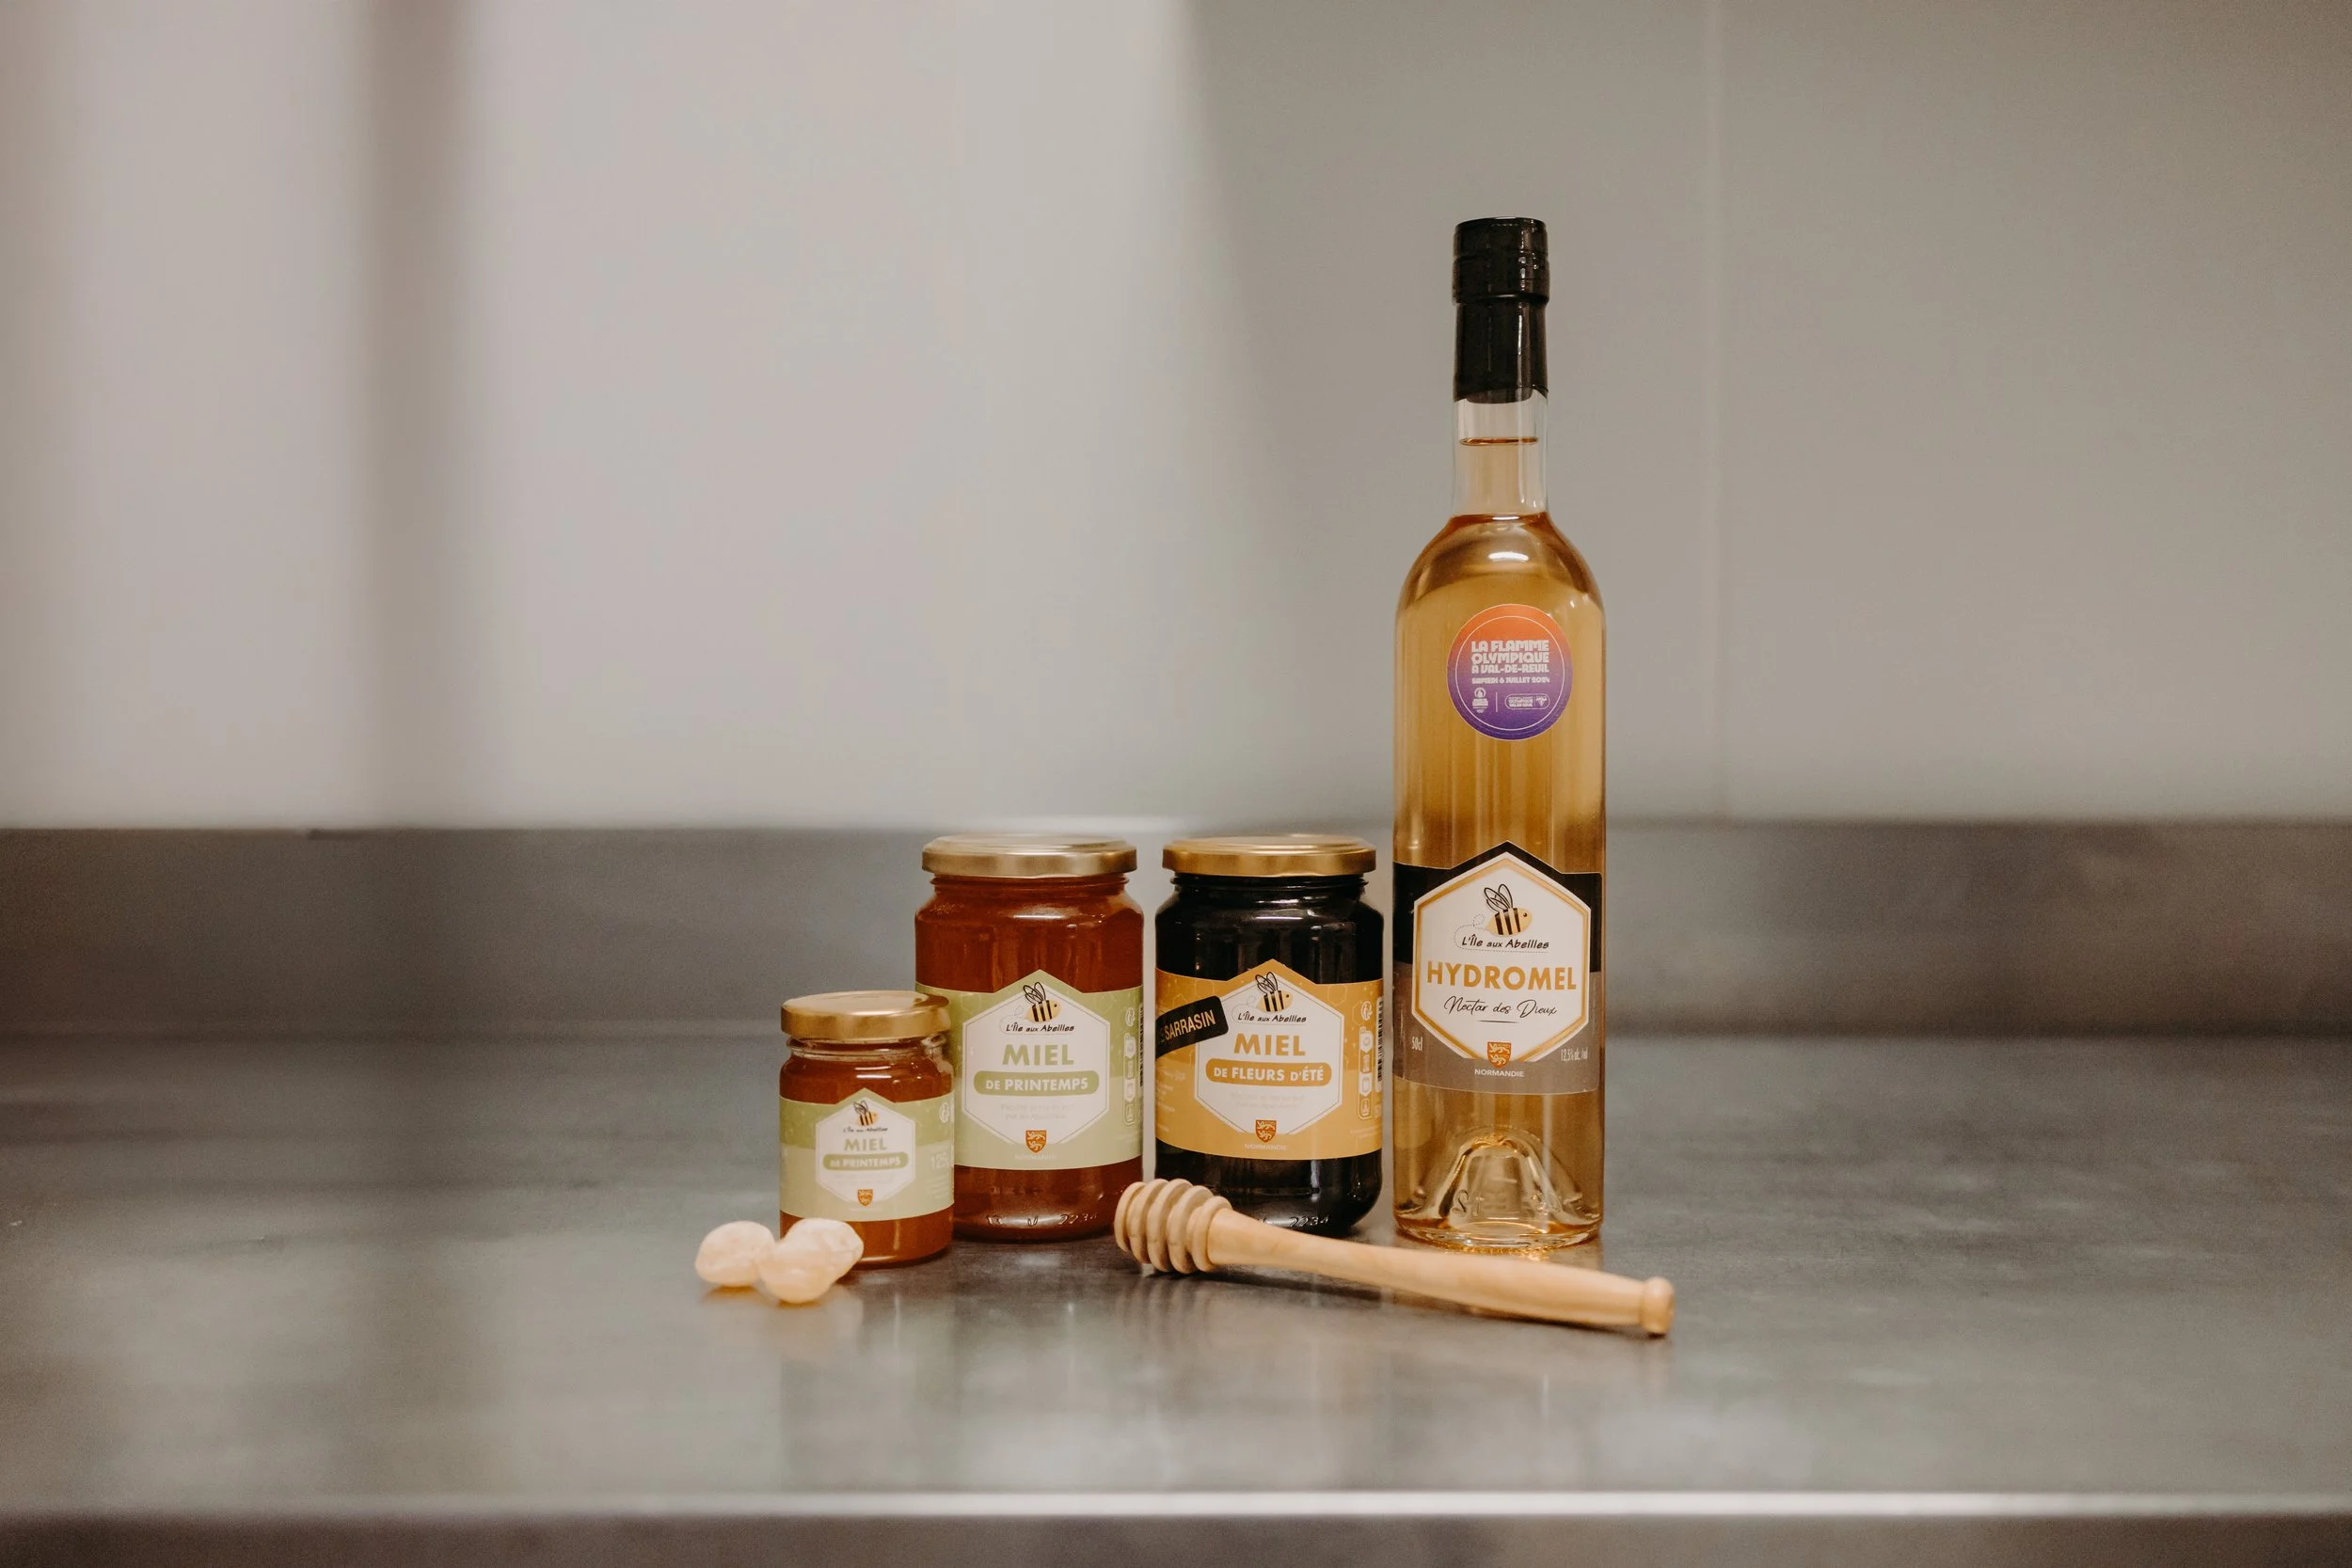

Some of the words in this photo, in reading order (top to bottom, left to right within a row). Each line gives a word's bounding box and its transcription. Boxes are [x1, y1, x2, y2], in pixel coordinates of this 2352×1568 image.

[1471, 641, 1488, 652] LA
[1491, 640, 1549, 652] FLAMME
[1471, 652, 1549, 665] OLYMPIQUE
[1481, 663, 1549, 673] VAL-DE-REUIL
[1461, 934, 1483, 947] L'Île
[1505, 939, 1549, 949] Abeilles
[1427, 961, 1577, 990] HYDROMEL
[1444, 996, 1488, 1016] Nectar
[1492, 1002, 1511, 1014] des
[1517, 1000, 1557, 1019] Dieux
[1164, 1009, 1216, 1041] SARRASIN
[1272, 1014, 1307, 1023] Abeilles
[1041, 1023, 1074, 1033] Abeilles
[1233, 1033, 1306, 1056] MIEL
[1002, 1044, 1074, 1066] MIEL
[1214, 1067, 1228, 1078] DE
[1232, 1067, 1285, 1082] FLEURS
[1290, 1066, 1324, 1082] D'ÉTÉ
[1474, 1069, 1524, 1078] NORMANDIE
[986, 1080, 1001, 1090] DE
[1005, 1077, 1089, 1092] PRINTEMPS
[844, 1138, 887, 1152] MIEL
[842, 1156, 901, 1168] PRINTEMPS
